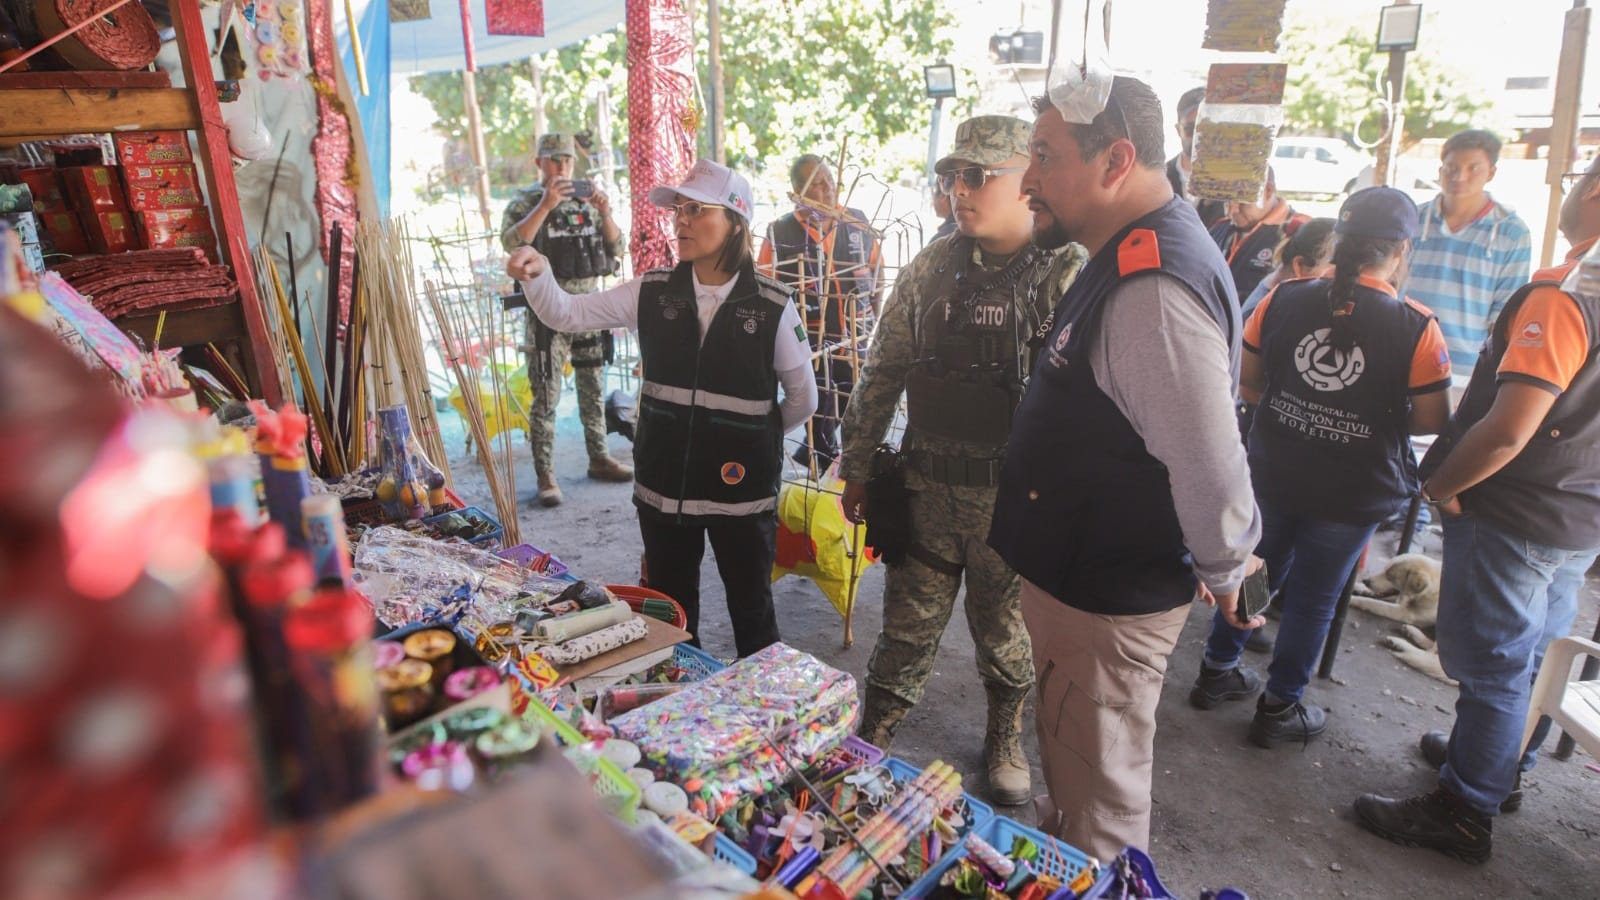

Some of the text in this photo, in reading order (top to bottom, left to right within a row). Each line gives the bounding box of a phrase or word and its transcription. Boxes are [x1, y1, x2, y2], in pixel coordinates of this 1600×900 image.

[1308, 402, 1345, 417] ESTATAL
[1346, 411, 1360, 420] DE
[1278, 415, 1350, 444] MORELOS
[1337, 420, 1372, 435] CIVIL
